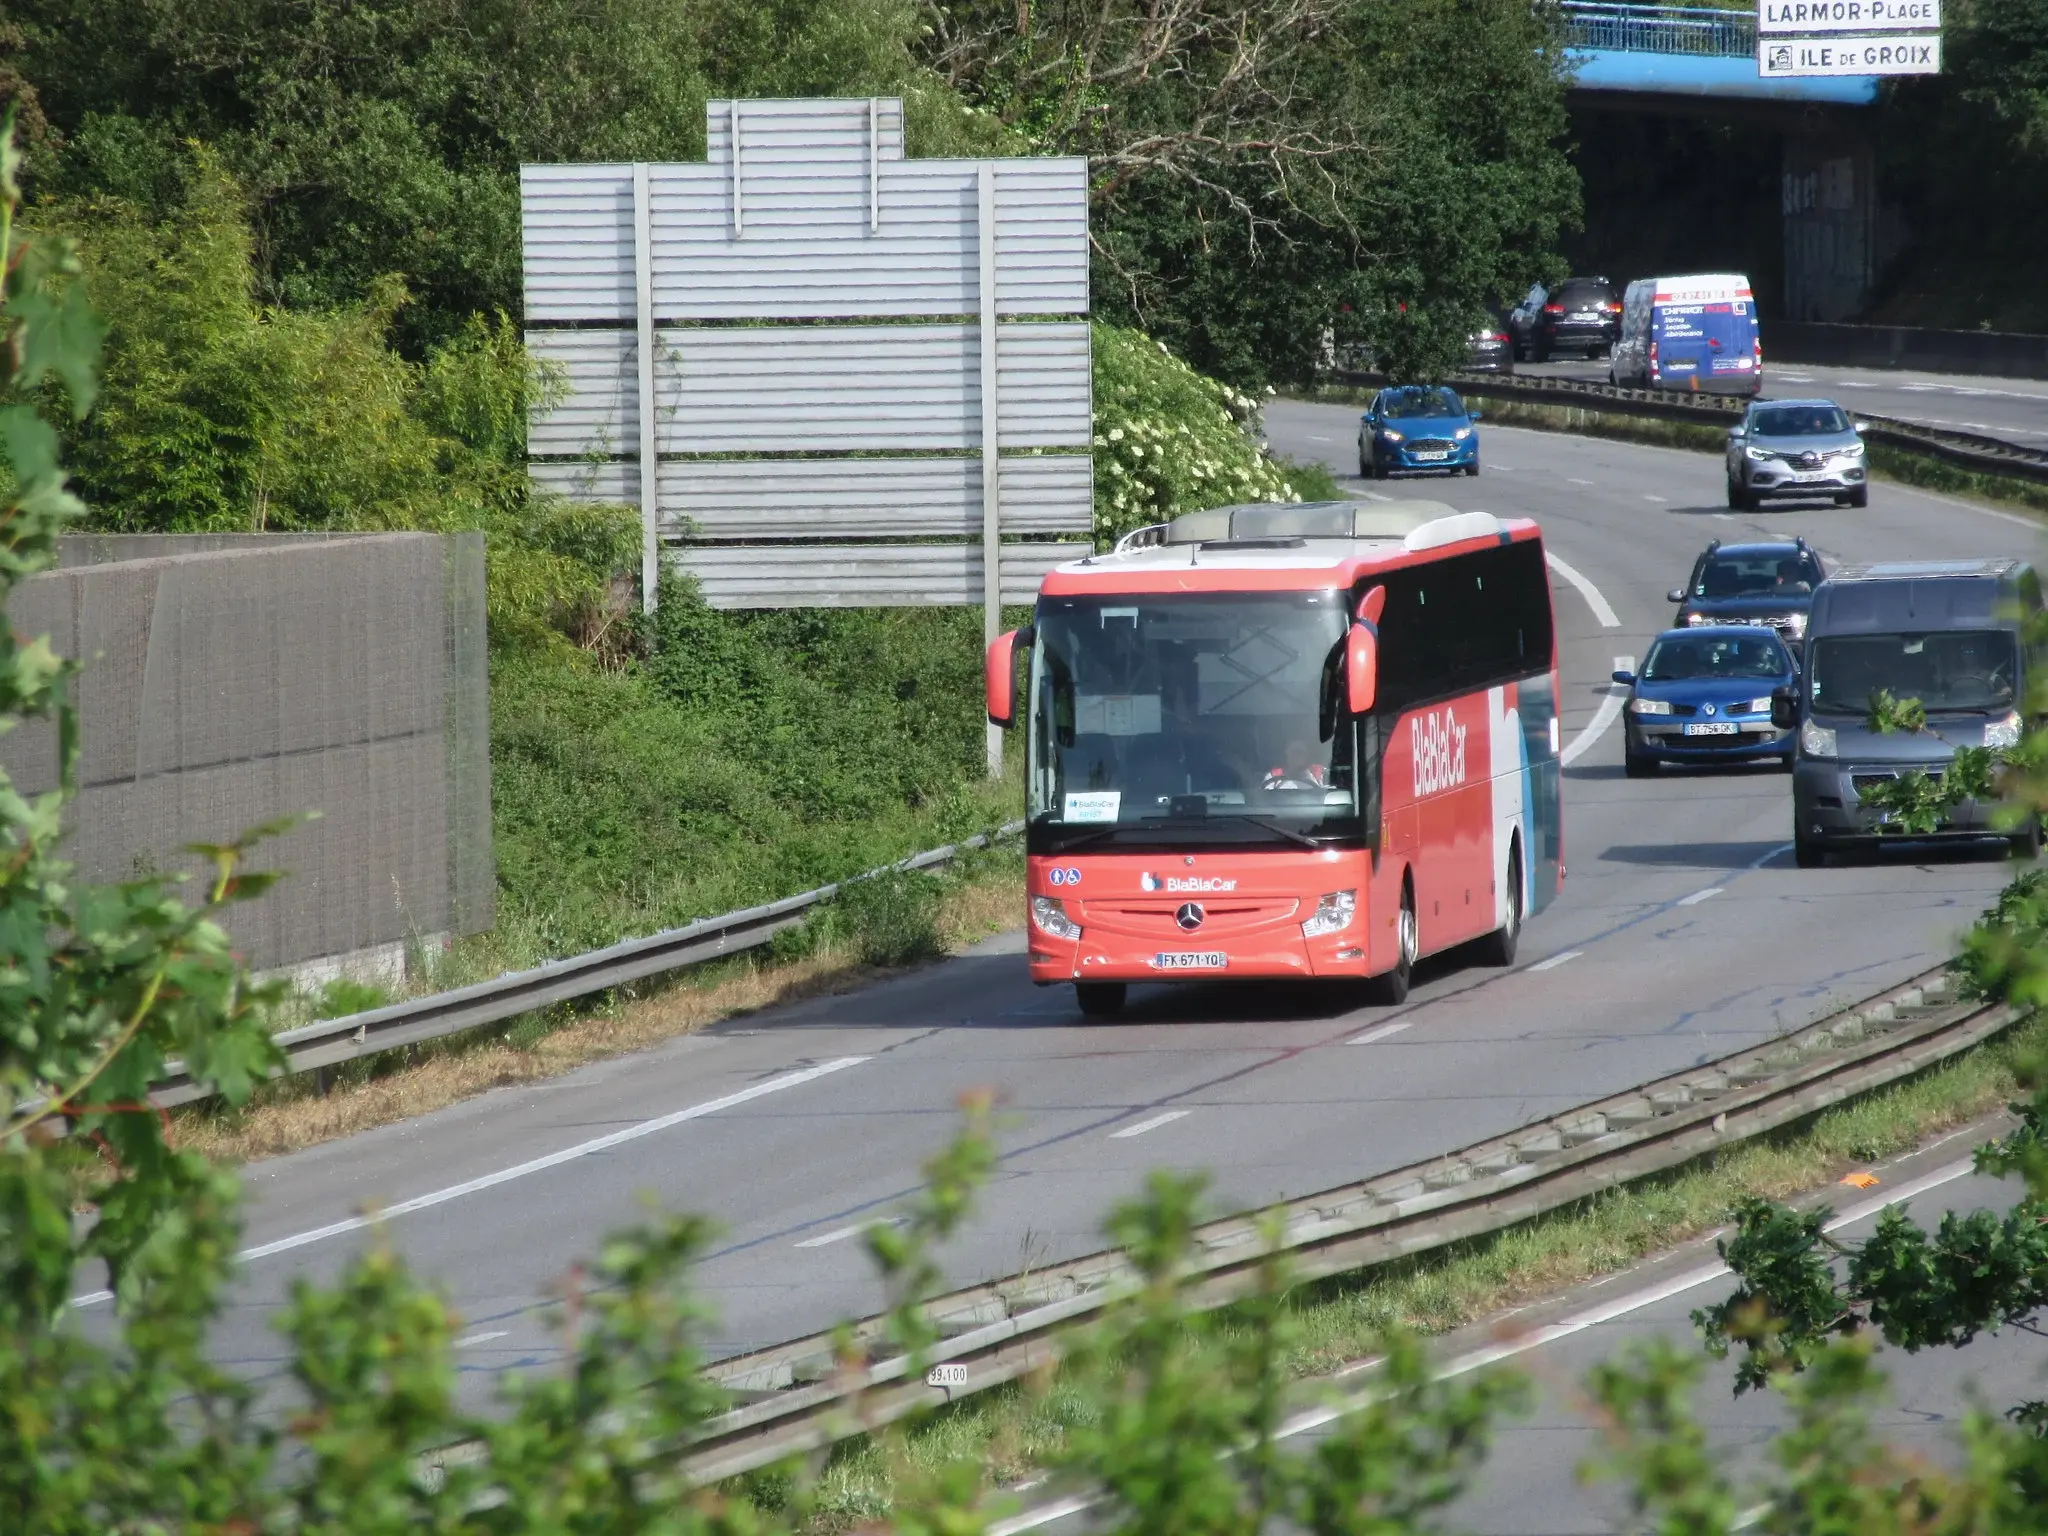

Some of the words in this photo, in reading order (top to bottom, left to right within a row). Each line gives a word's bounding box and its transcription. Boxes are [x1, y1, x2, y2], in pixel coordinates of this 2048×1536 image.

[1768, 1, 1932, 22] LARMOR-PLAGE
[1801, 49, 1832, 66] ILE
[1864, 46, 1931, 64] GROIX
[1411, 707, 1466, 797] BlaBlaCar
[1167, 877, 1237, 892] BlaBlaCar
[931, 1368, 965, 1381] 99.100
